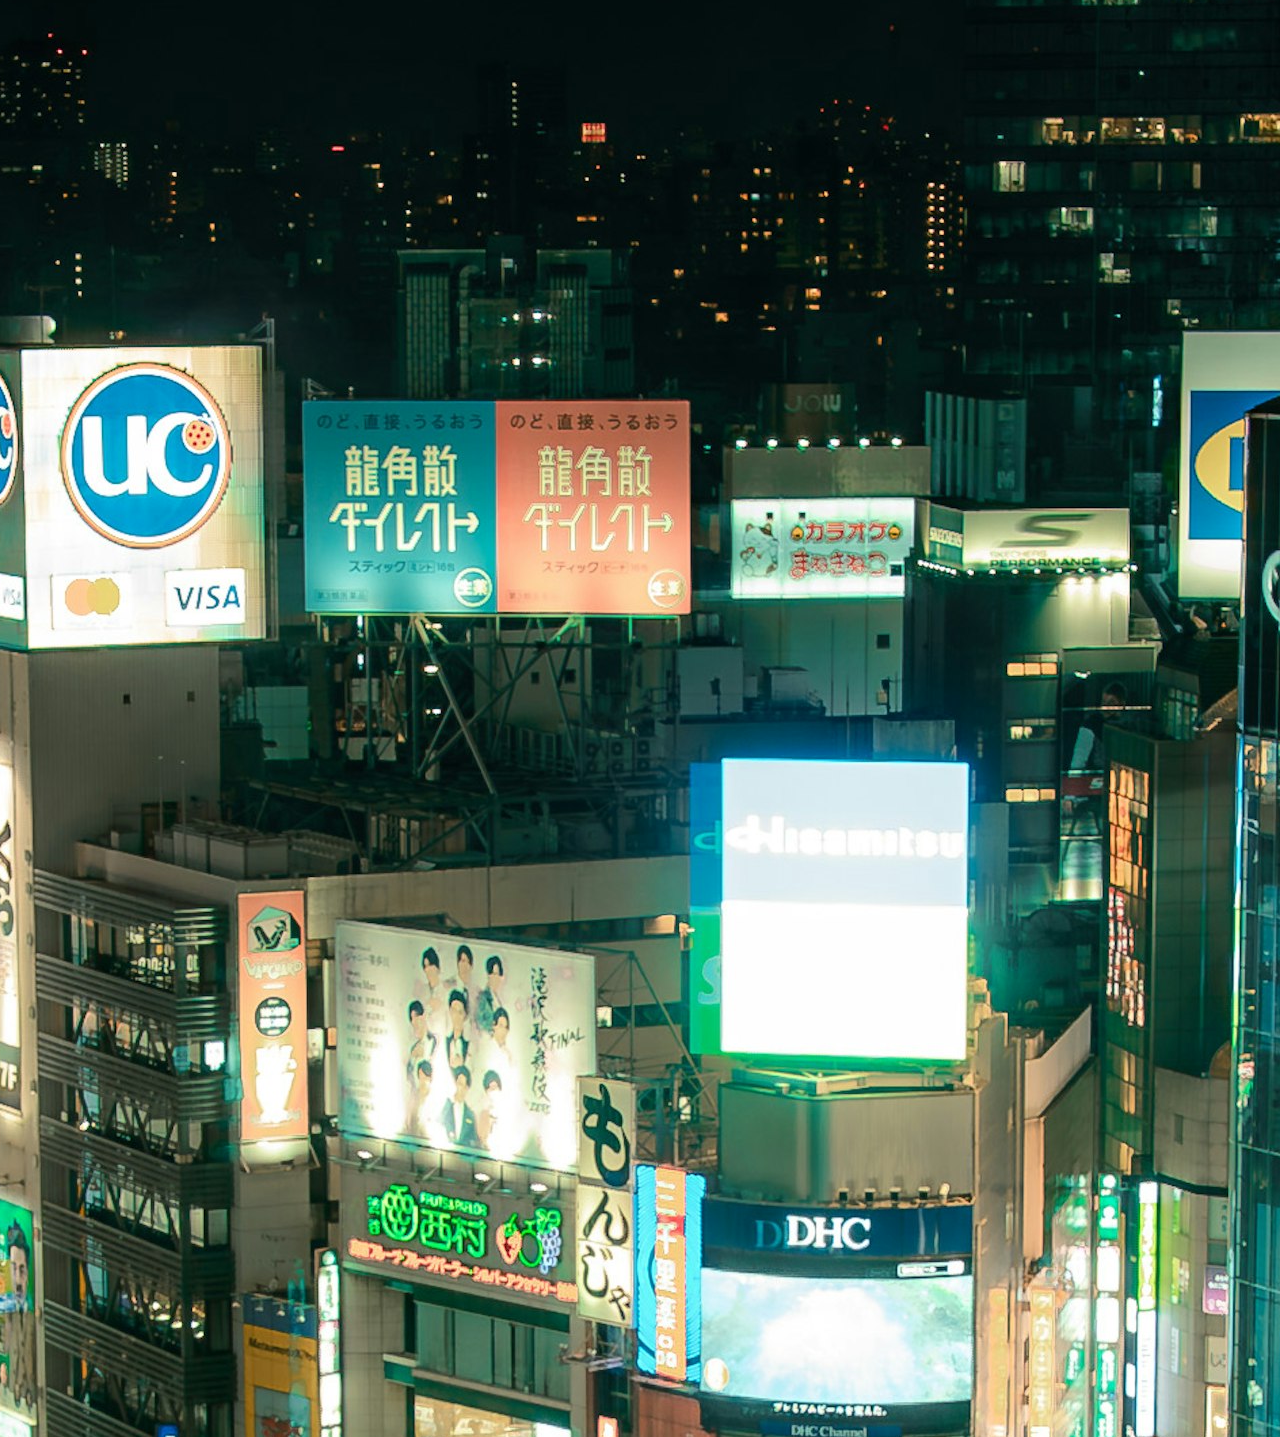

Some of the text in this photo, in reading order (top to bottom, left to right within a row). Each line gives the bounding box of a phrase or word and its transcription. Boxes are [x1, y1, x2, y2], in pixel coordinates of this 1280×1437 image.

[317, 414, 483, 430] のど、直接、うるおう
[510, 414, 678, 431] のど、直接、うるおう
[345, 445, 458, 497] 龍角散
[537, 445, 652, 497] 龍角散
[329, 502, 480, 553] ダイレクト
[523, 503, 674, 553] ダイレクト
[805, 521, 888, 542] カラオケ
[349, 560, 406, 573] スティック
[542, 560, 599, 574] スティック
[790, 549, 889, 580] まねきねこ
[989, 558, 1101, 569] PERFORMANCE
[174, 584, 240, 610] VISA
[549, 1026, 587, 1051] FINAL
[0, 1061, 18, 1090] 7F
[581, 1081, 632, 1321] もんじゃ
[419, 1207, 488, 1259] 西村
[786, 1214, 872, 1250] DHC
[655, 1179, 677, 1369] 三千里薬品
[791, 1425, 822, 1437] DHC
